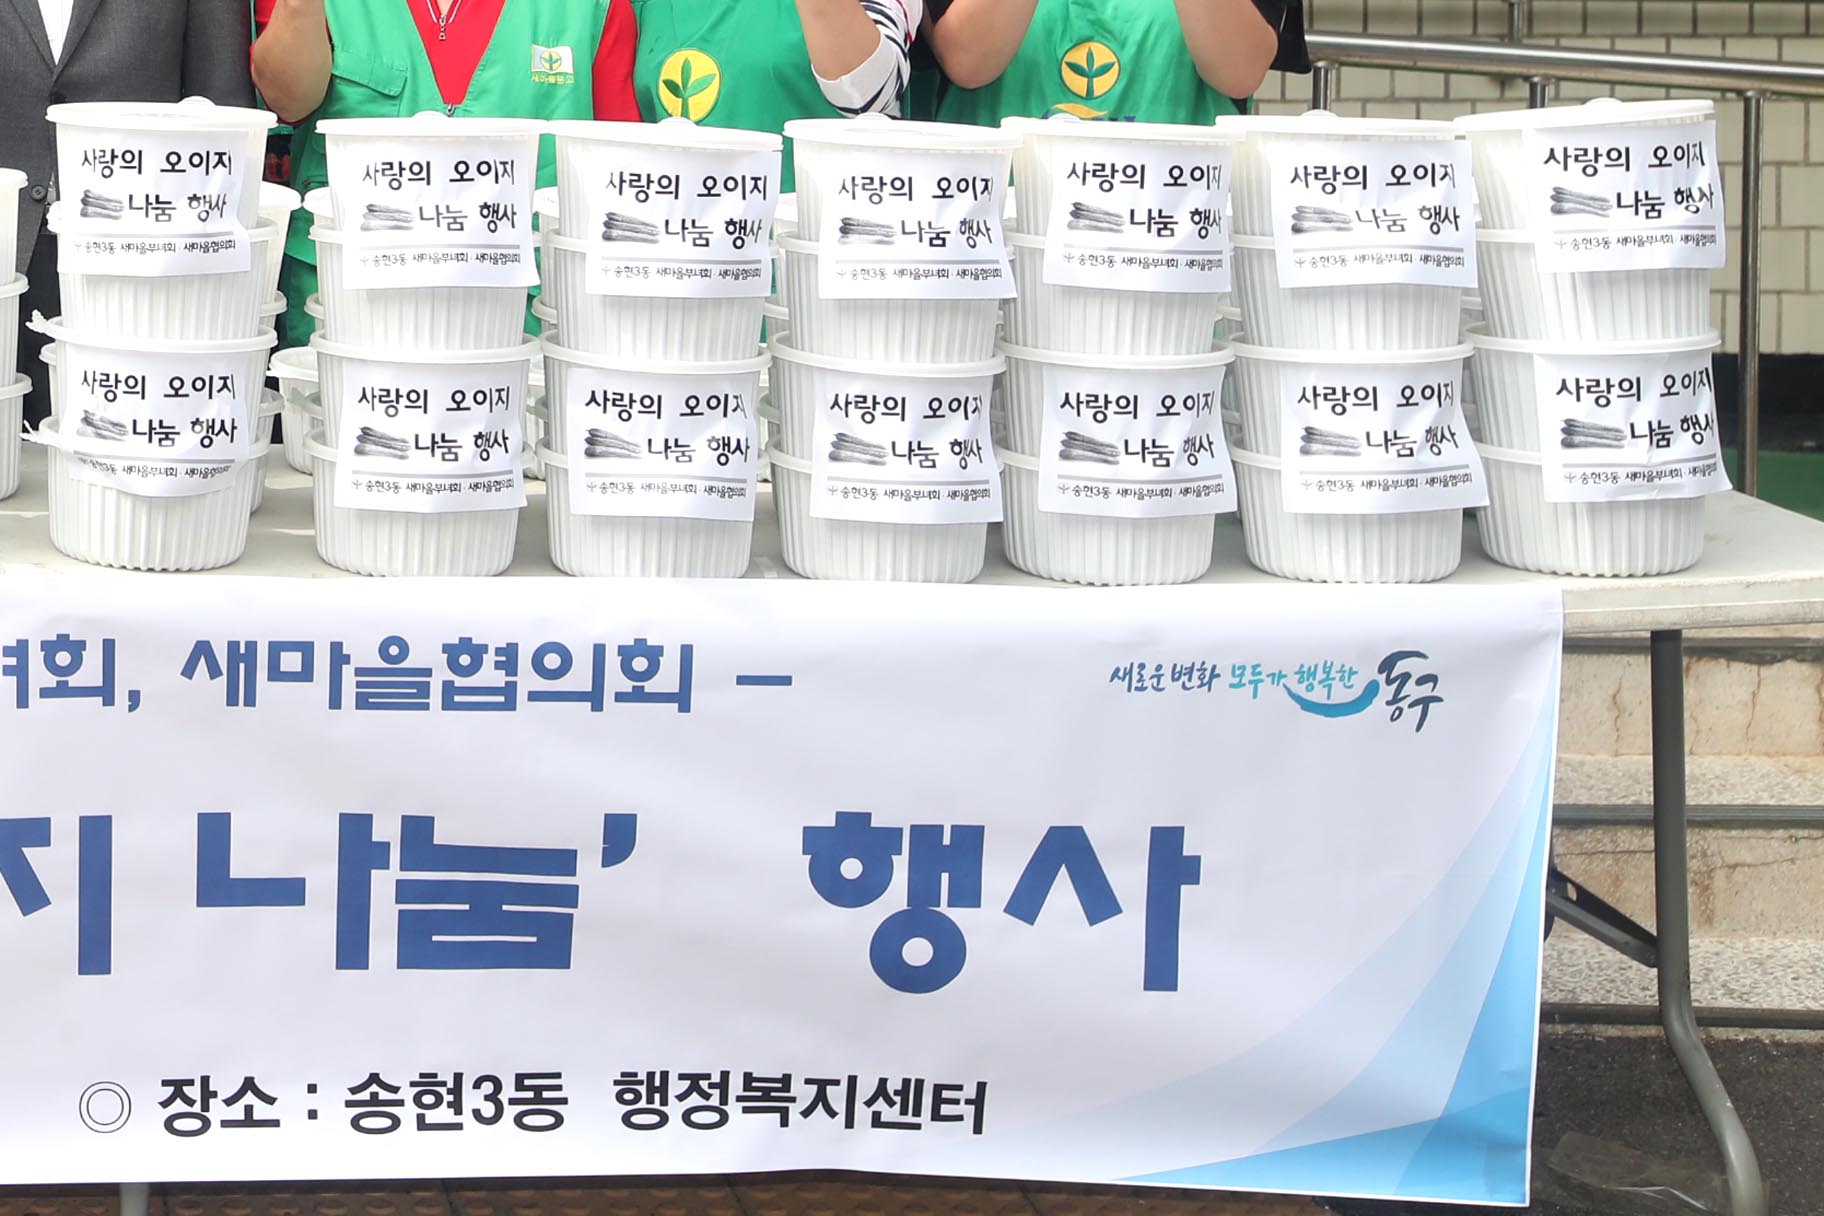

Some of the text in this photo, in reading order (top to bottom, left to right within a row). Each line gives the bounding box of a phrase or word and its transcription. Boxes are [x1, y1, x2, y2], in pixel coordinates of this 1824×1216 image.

[82, 149, 231, 178] 사랑의 오이지
[1544, 141, 1705, 177] 사랑의 오이지
[608, 172, 767, 203] 사랑의 오이지
[1067, 162, 1221, 192] 사랑의 오이지
[1291, 163, 1455, 194] 사랑의 오이지
[129, 194, 226, 222] 나눔 행사
[1617, 184, 1714, 219] 나눔 행사
[665, 218, 761, 249] 나눔 행사
[1130, 208, 1221, 239] 나눔 행사
[1355, 205, 1460, 235] 나눔 행사
[180, 634, 694, 714] 새마을협의회
[1108, 649, 1443, 733] 새로운 변화 모두가 행복한 동구
[196, 811, 638, 971] 나눔'
[802, 811, 1202, 994] 행사
[157, 1074, 281, 1137] 장소
[342, 1071, 570, 1134] 송현3동
[611, 1069, 989, 1135] 행정복지센터
